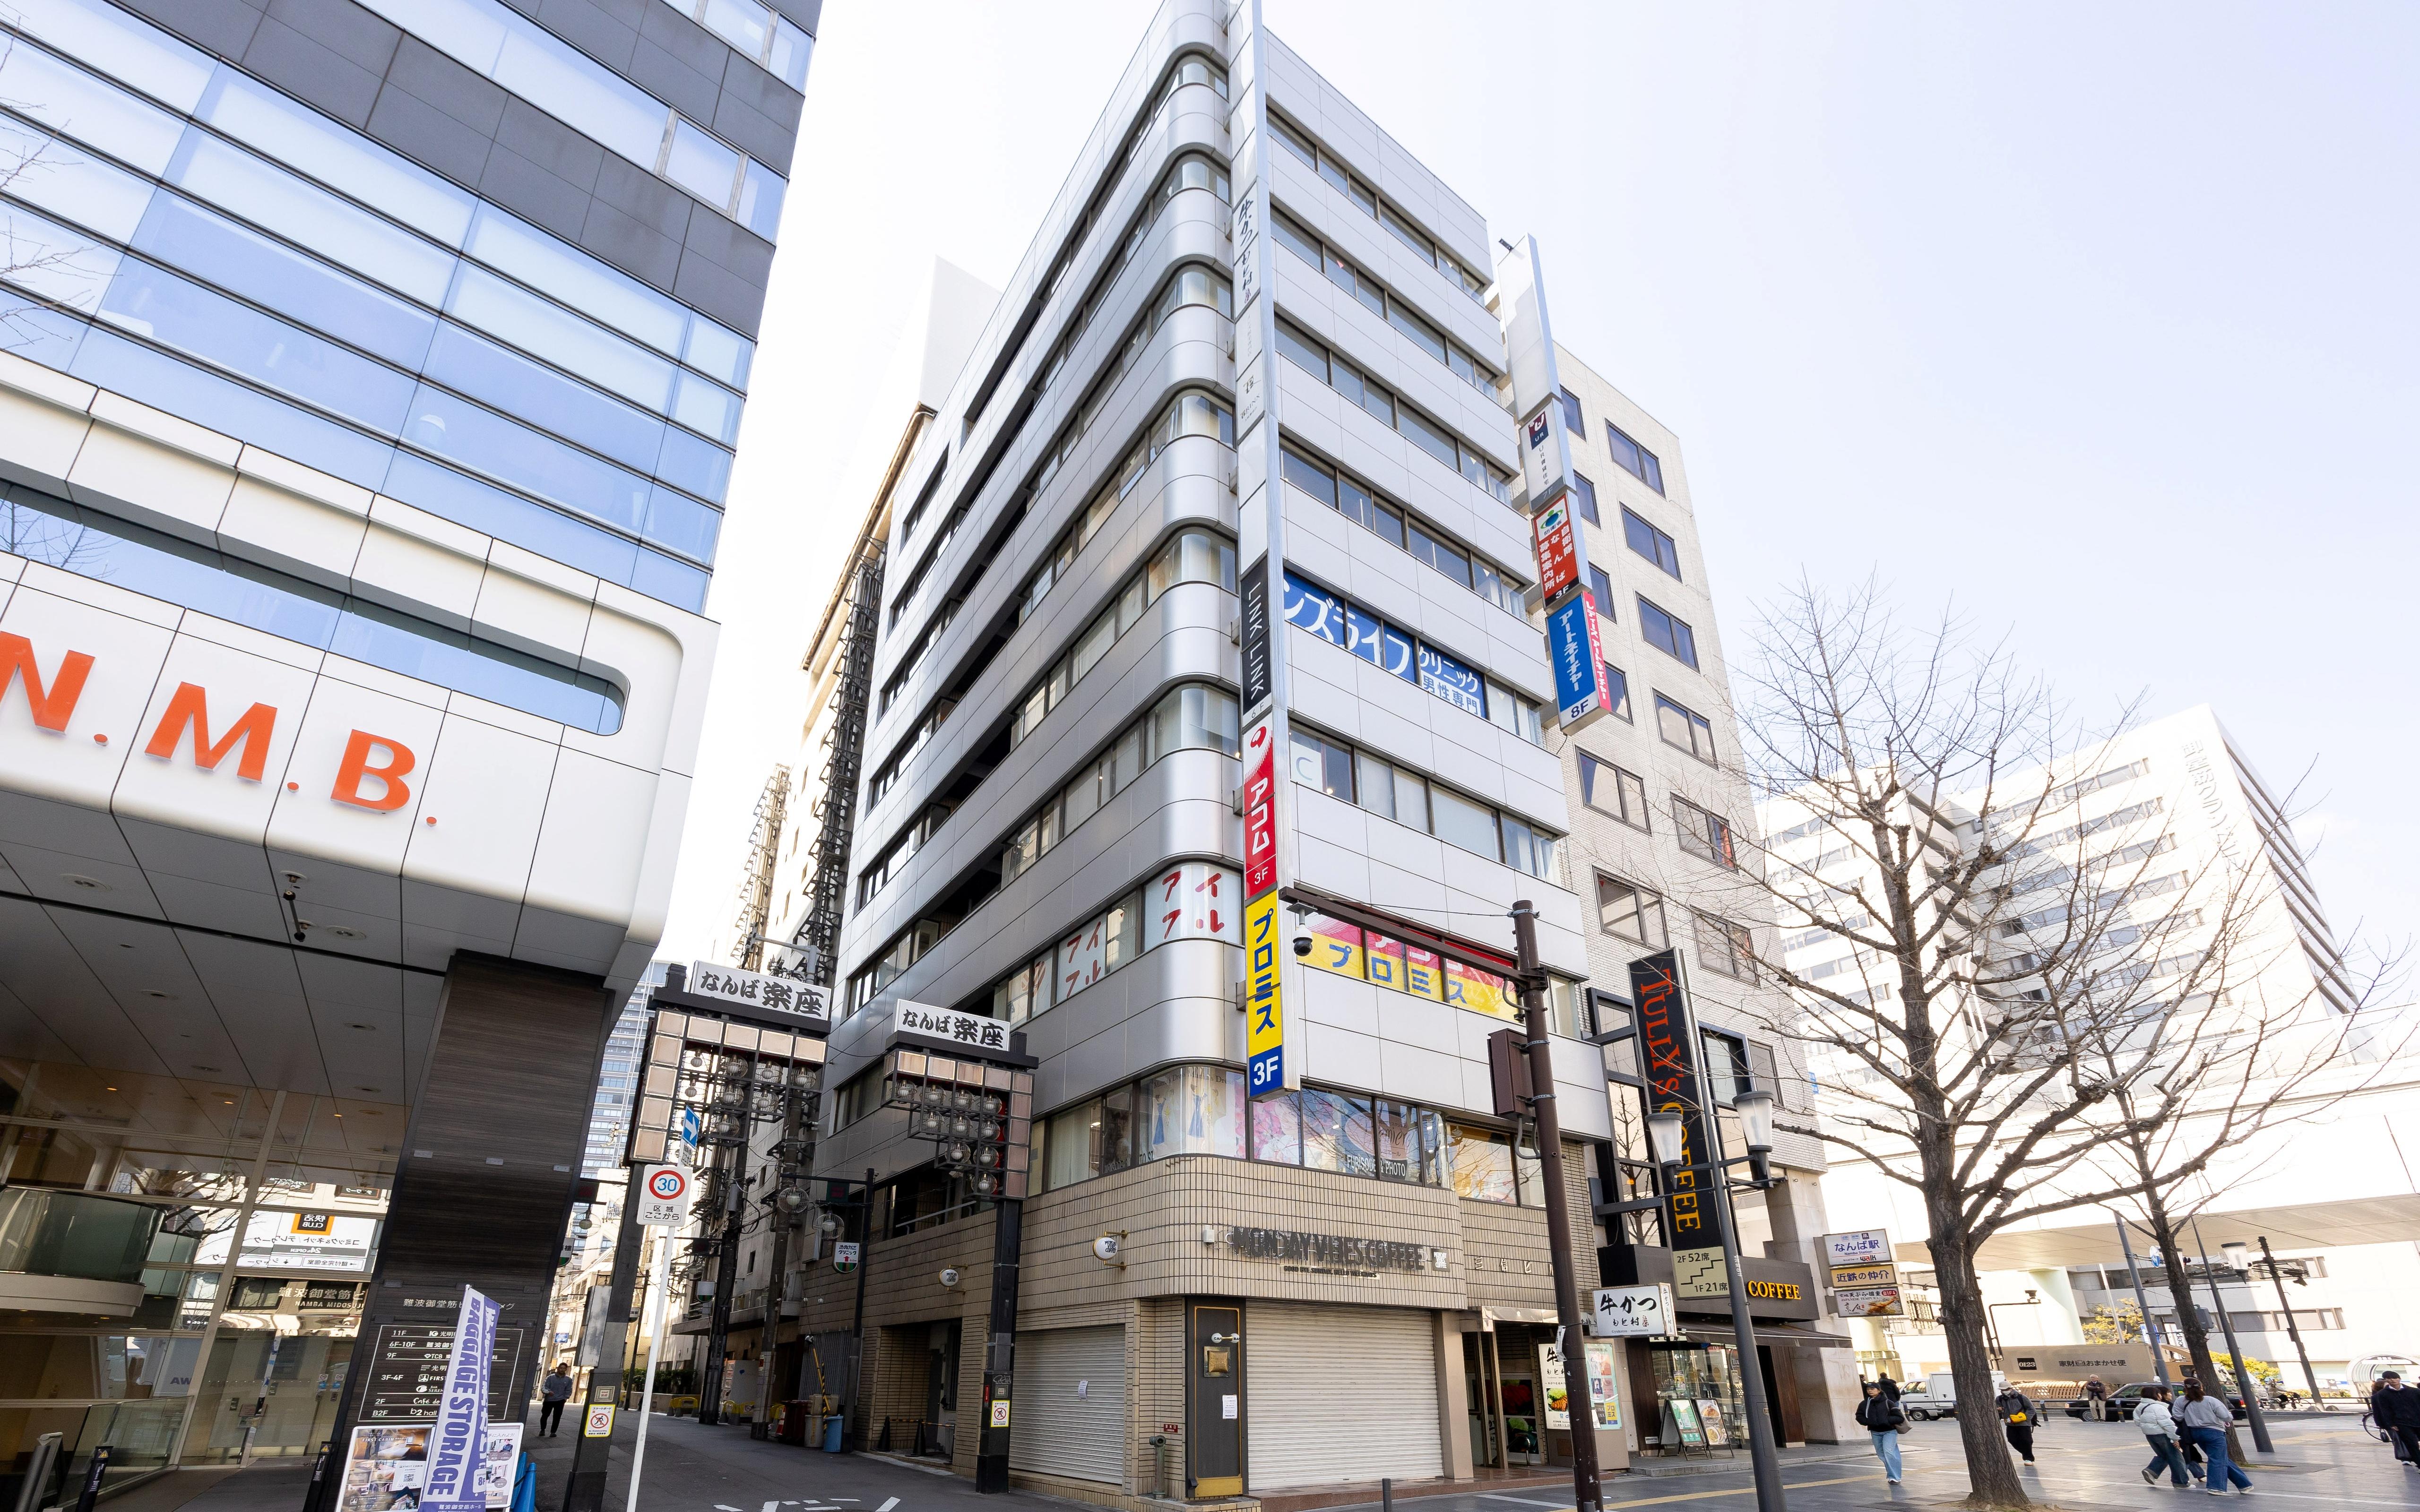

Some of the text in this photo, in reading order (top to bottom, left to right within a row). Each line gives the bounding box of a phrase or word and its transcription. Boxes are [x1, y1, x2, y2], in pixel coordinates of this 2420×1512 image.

[1535, 432, 1544, 442] UR
[1542, 486, 1554, 499] 7F
[1544, 520, 1562, 536] 防衛省
[1561, 524, 1573, 557] 自衛隊
[1539, 540, 1555, 591] 募集案内所
[1551, 534, 1565, 583] なんば
[1556, 585, 1569, 599] 3F
[1248, 582, 1264, 700] LINK LINK
[1559, 609, 1582, 692] アートネイチャー
[1418, 646, 1478, 693] クリニック
[1251, 701, 1264, 718] 6F
[1423, 674, 1481, 716] 男性専門
[1571, 699, 1589, 718] 8F
[1251, 777, 1270, 856] アコム
[1162, 870, 1222, 902] アイ
[1254, 866, 1269, 885] 3F
[1162, 909, 1225, 940] フル
[1067, 921, 1102, 964] アイ
[1065, 959, 1102, 998] フル
[1253, 907, 1277, 1036] プロミス
[1329, 944, 1468, 1005] プロミス
[700, 970, 823, 1017] なんば楽座
[902, 1008, 1004, 1048] なんば楽座
[1641, 969, 1684, 1095] TULLY'S
[1253, 1056, 1279, 1086] 3F
[1347, 1155, 1376, 1172] FURISODE
[1385, 1160, 1406, 1177] PHOTO
[657, 1178, 677, 1192] 30
[645, 1212, 680, 1220] ここから
[1233, 1226, 1424, 1270] MONDAY VIBES COFFEE
[1688, 1252, 1710, 1263] 52席
[1834, 1239, 1880, 1252] なんば駅
[1705, 1282, 1728, 1292] 21席
[1748, 1280, 1801, 1300] COFFEE
[1836, 1270, 1889, 1282] 近鉄の仲介
[1600, 1293, 1657, 1315] 牛かつ
[1613, 1316, 1640, 1327] もと村
[452, 1296, 481, 1395] BAGGAGE
[427, 1396, 475, 1496] STORAGE
